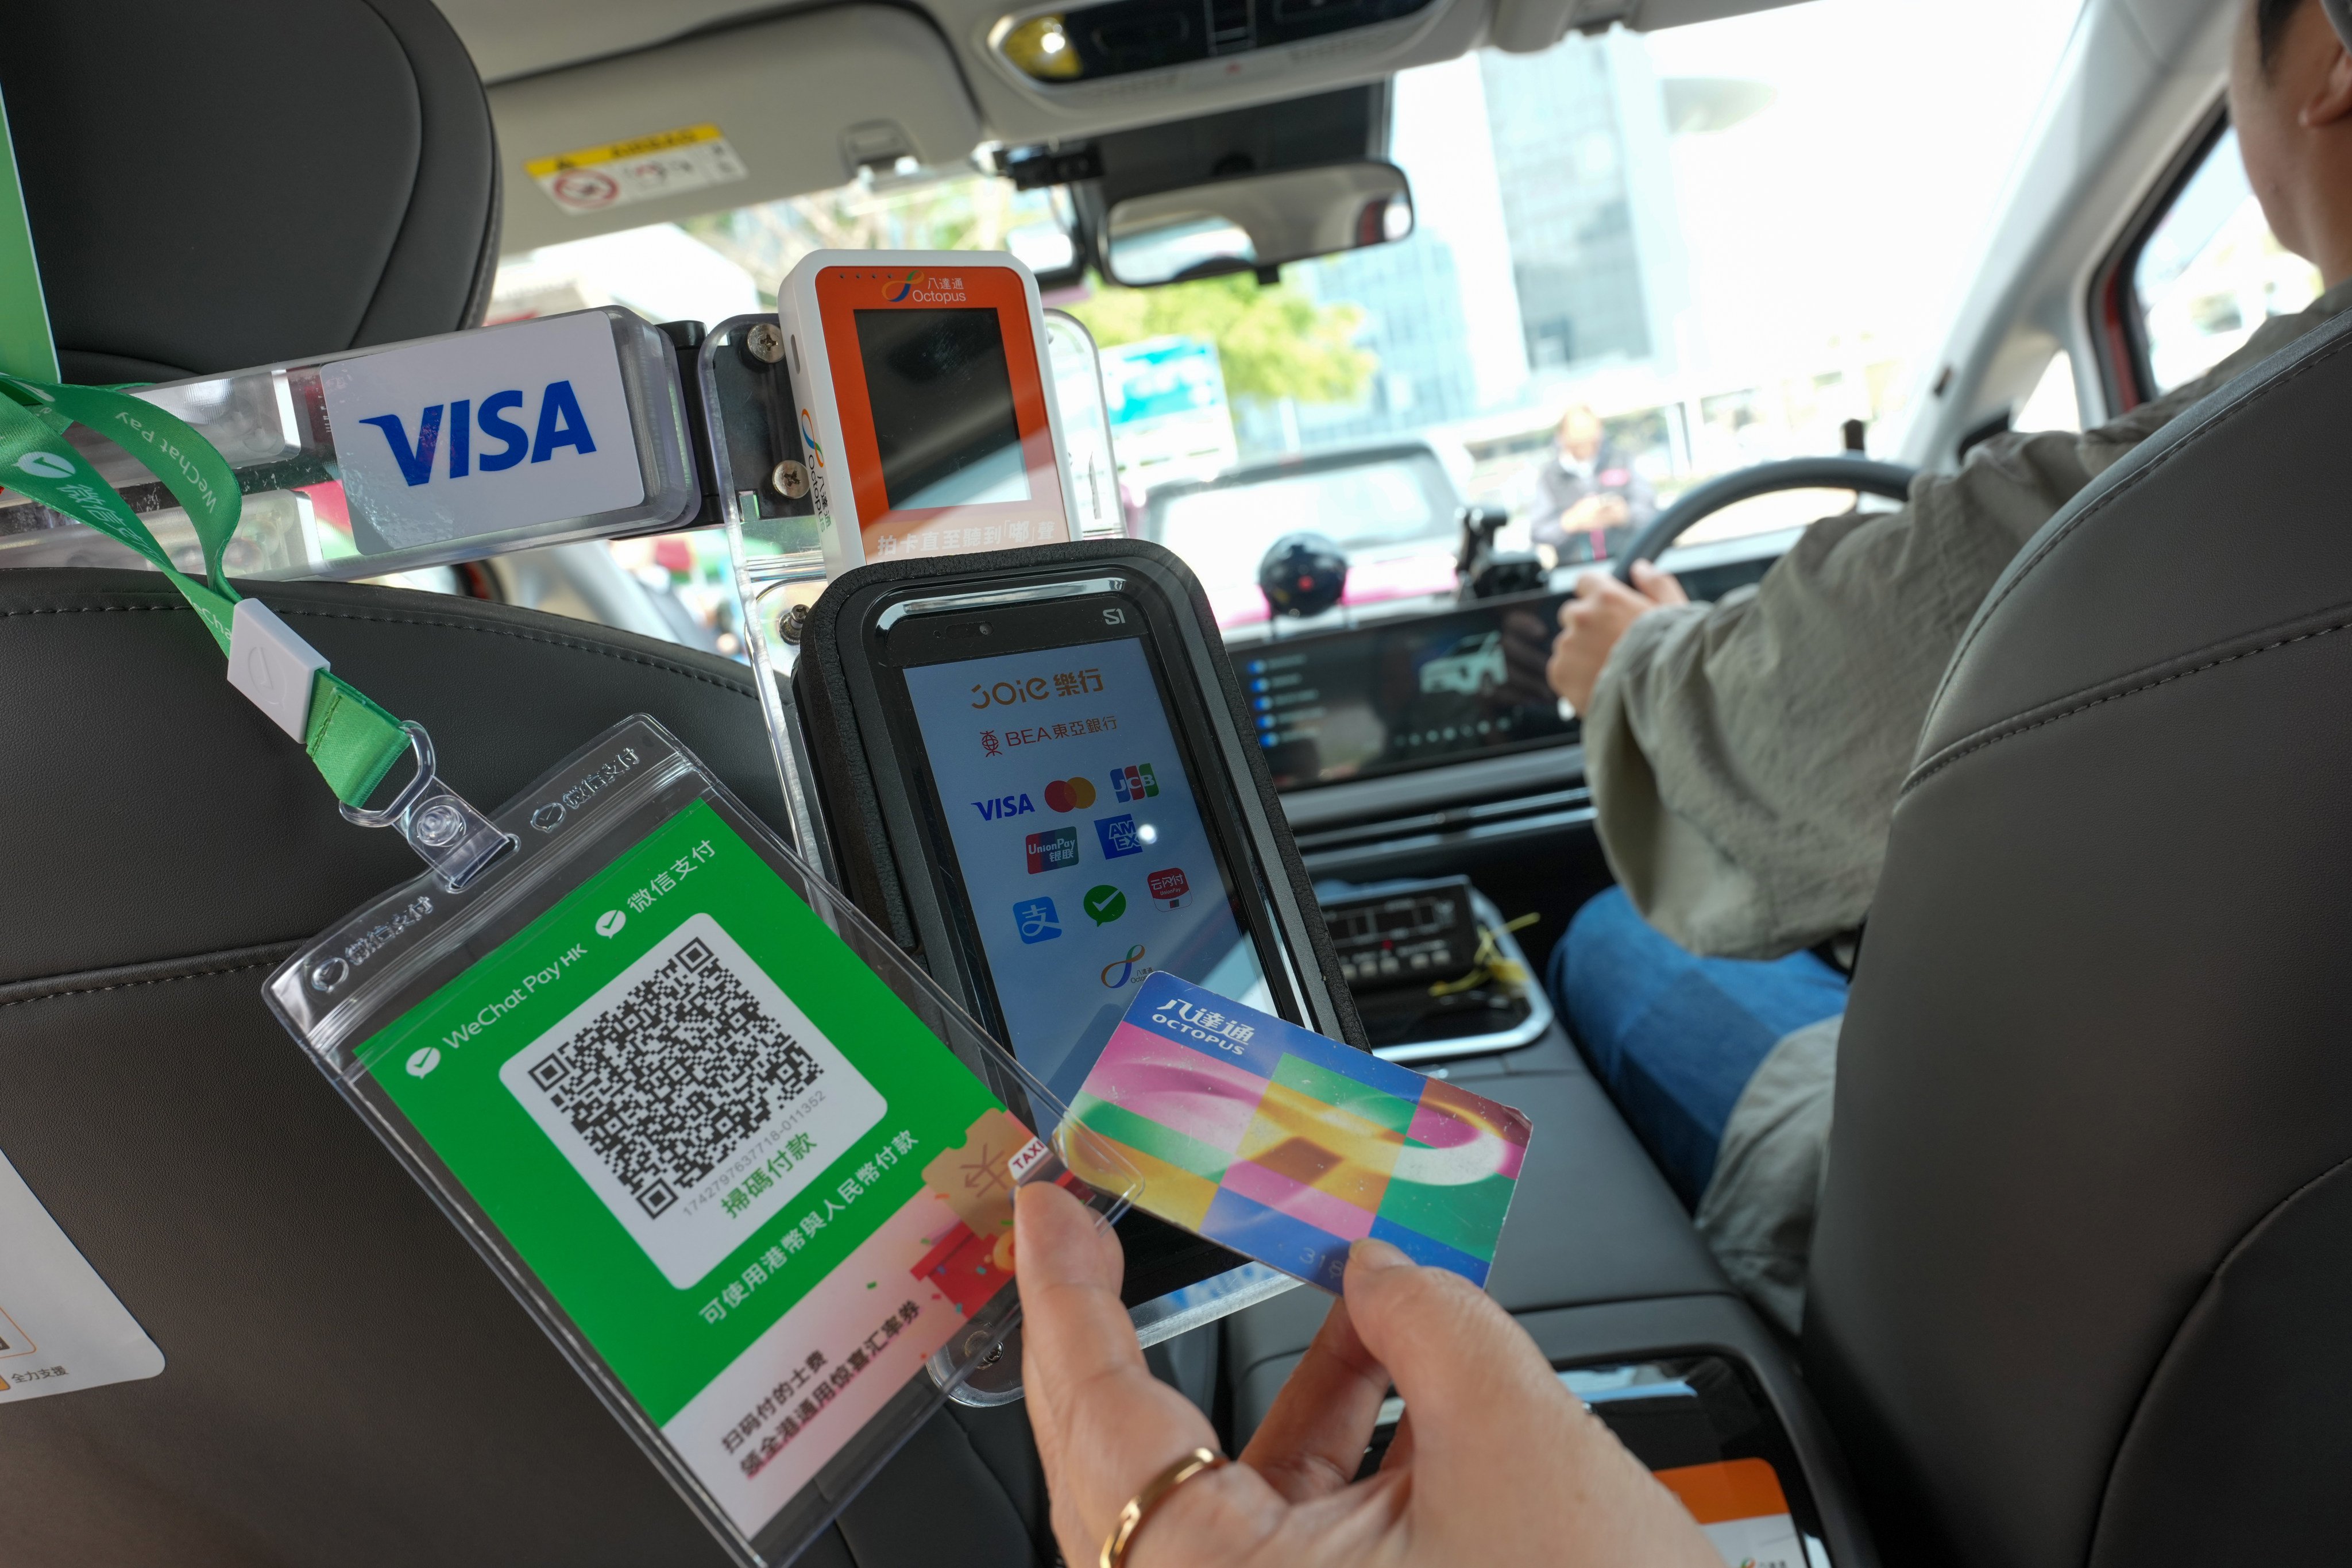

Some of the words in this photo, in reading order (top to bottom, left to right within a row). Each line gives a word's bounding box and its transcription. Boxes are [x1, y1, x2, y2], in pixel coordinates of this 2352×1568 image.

[912, 289, 966, 305] Octopus
[928, 277, 964, 290] 八達通
[115, 412, 156, 443] Pay
[359, 380, 597, 486] VISA
[160, 439, 216, 514] WeChat
[809, 454, 825, 533] Octopus
[817, 476, 832, 529] 八達通
[1053, 668, 1104, 697] 樂行
[1005, 727, 1052, 747] BEA
[1052, 716, 1117, 739] 東亞銀行
[1115, 774, 1156, 793] JCB
[971, 793, 1036, 821] VISA
[1028, 838, 1075, 855] UnionPay
[1049, 848, 1074, 862] 银联
[626, 838, 717, 914] 微信支付
[1160, 887, 1181, 896] UnionPay
[442, 988, 525, 1049] WeChat
[522, 960, 562, 994] Pay
[560, 943, 589, 967] HK
[1152, 1013, 1245, 1056] OCTOPUS
[1156, 998, 1256, 1045] 八達通
[682, 1089, 827, 1217] 1742797637718-011352
[1012, 1140, 1045, 1169] TAXI
[720, 1131, 817, 1220] 掃碼付款
[698, 1129, 920, 1325] 可使用港幣與人民幣付款
[11, 1365, 69, 1384] 全力支援
[721, 1349, 828, 1455] 扫码付的士费
